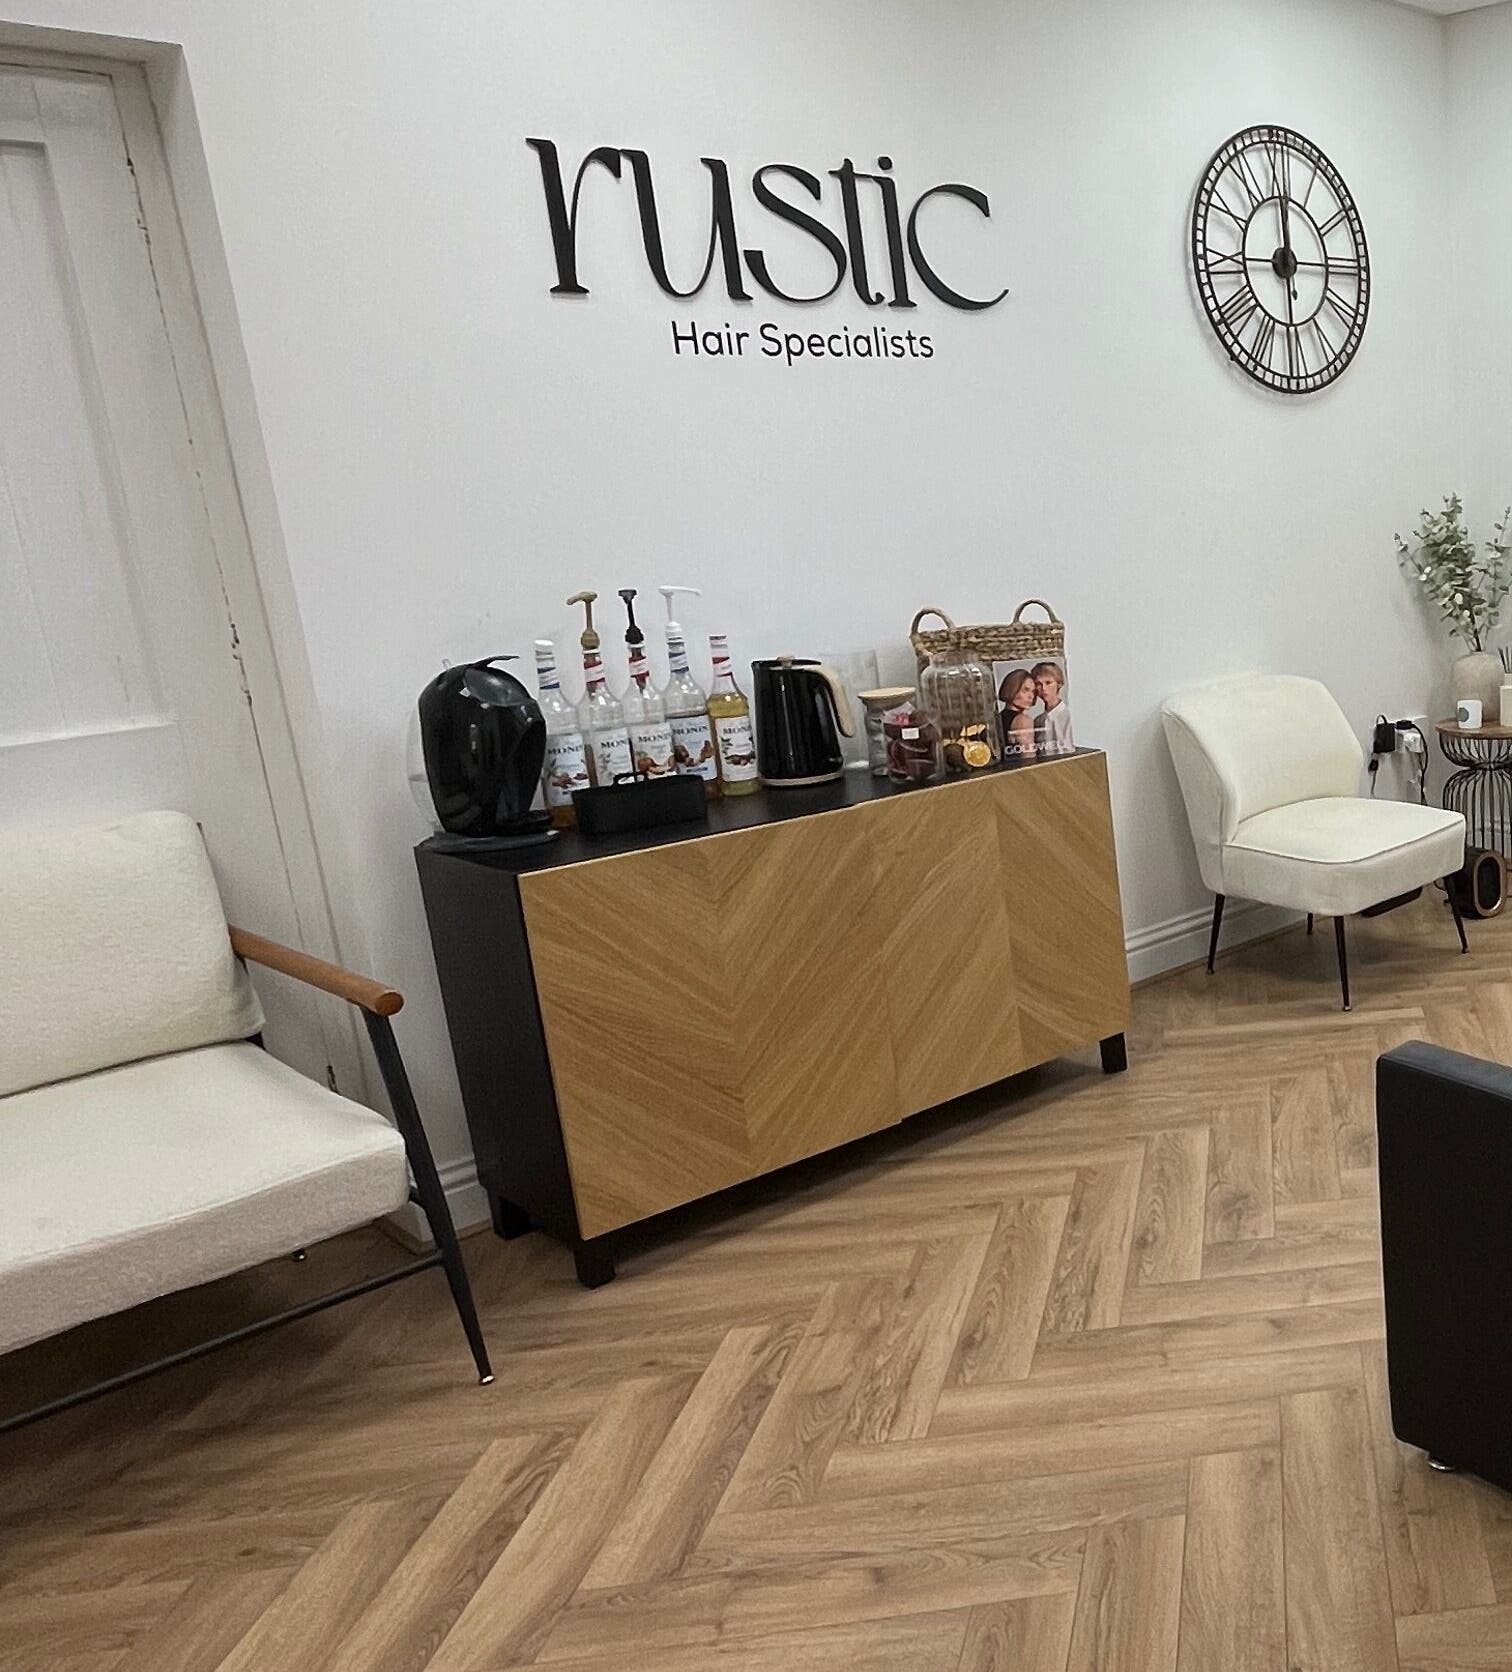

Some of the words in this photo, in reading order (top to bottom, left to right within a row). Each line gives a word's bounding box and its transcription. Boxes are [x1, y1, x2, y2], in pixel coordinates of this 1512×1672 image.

[525, 137, 1010, 311] rustic
[671, 320, 750, 357] Hair
[759, 323, 935, 366] Specialists
